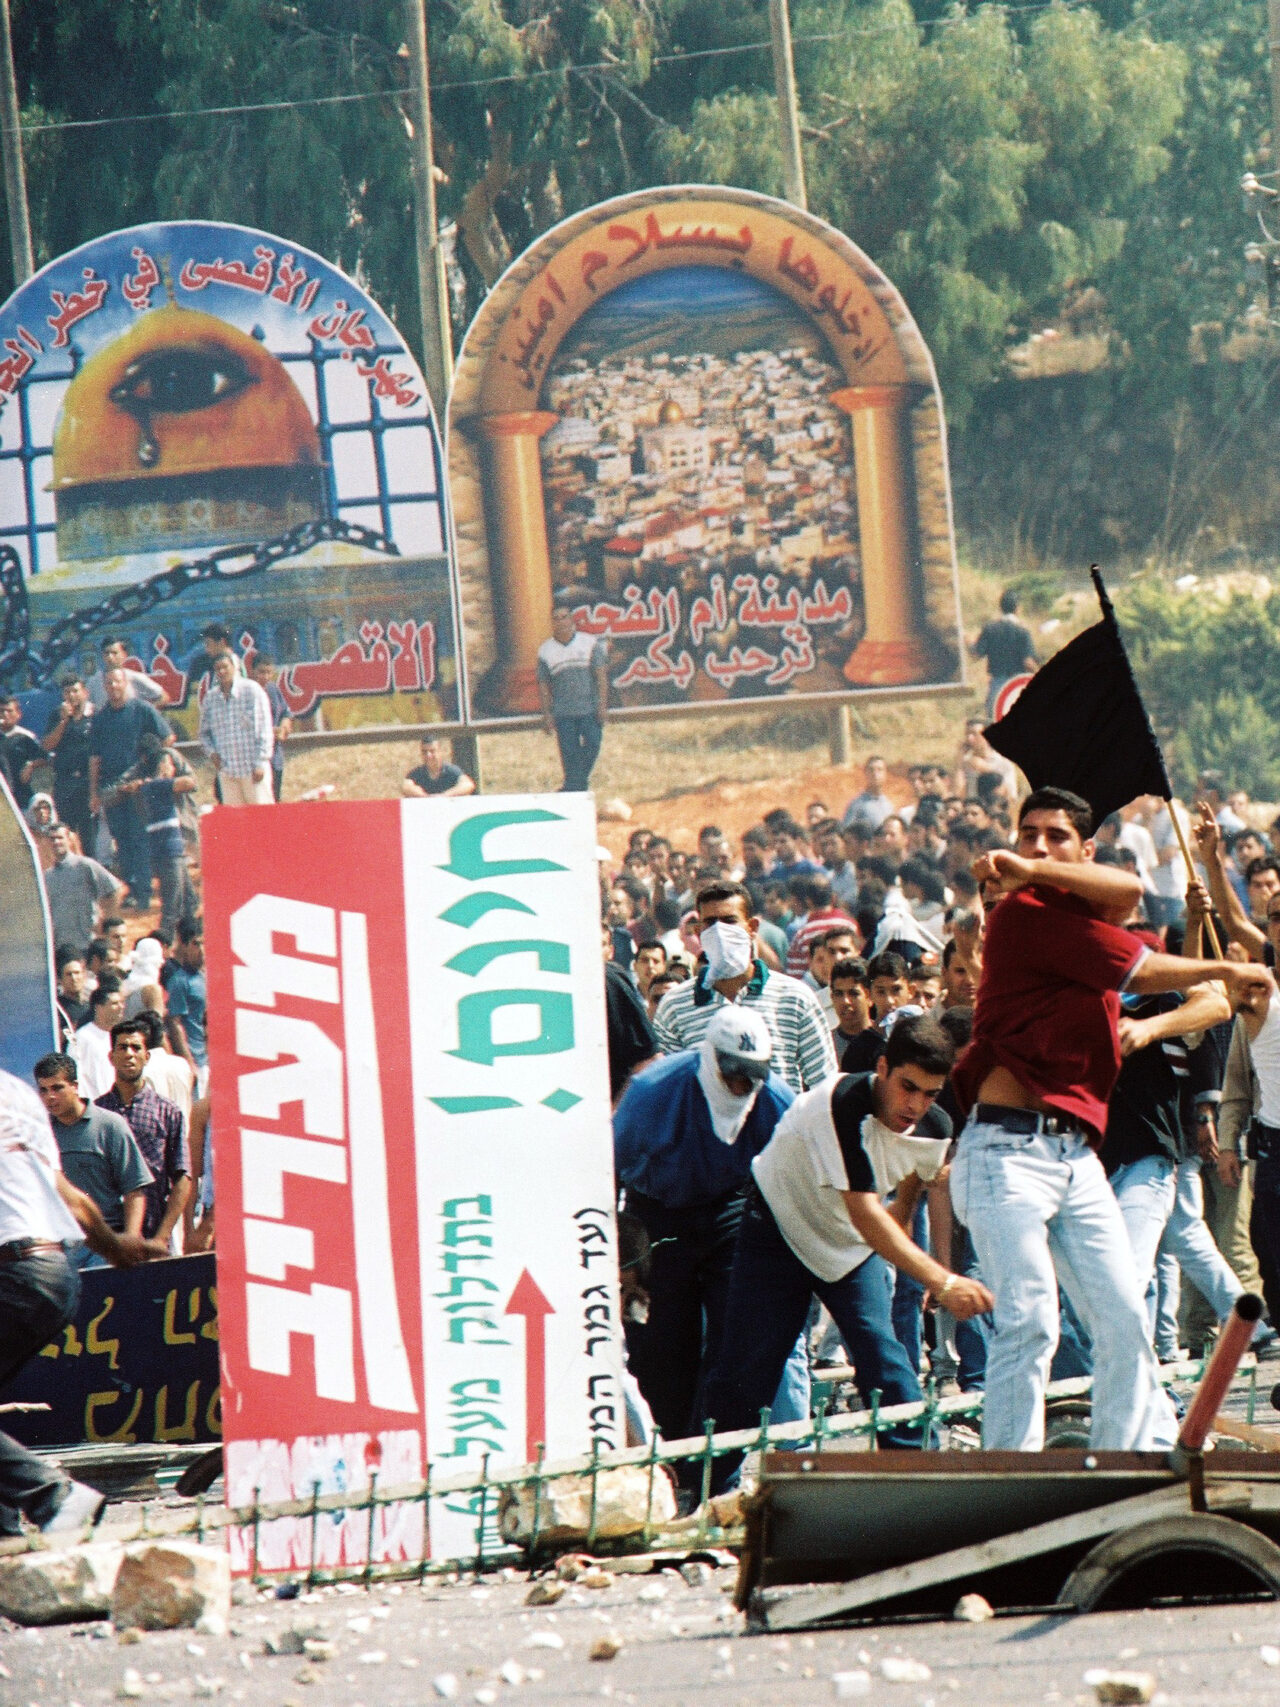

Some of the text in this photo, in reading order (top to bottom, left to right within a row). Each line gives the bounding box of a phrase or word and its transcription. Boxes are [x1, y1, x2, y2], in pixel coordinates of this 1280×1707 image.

[122, 246, 160, 310] في
[582, 212, 753, 293] بسلام
[47, 267, 108, 348] خطر
[690, 573, 728, 646] أم
[736, 573, 851, 624] مدينة
[611, 624, 815, 688] ترحب بكم
[423, 808, 584, 1115] חינם!
[230, 892, 356, 1404] מעריב
[431, 1192, 513, 1346] בתדלוק
[579, 1284, 612, 1358] גמר
[434, 1377, 507, 1459] מעל
